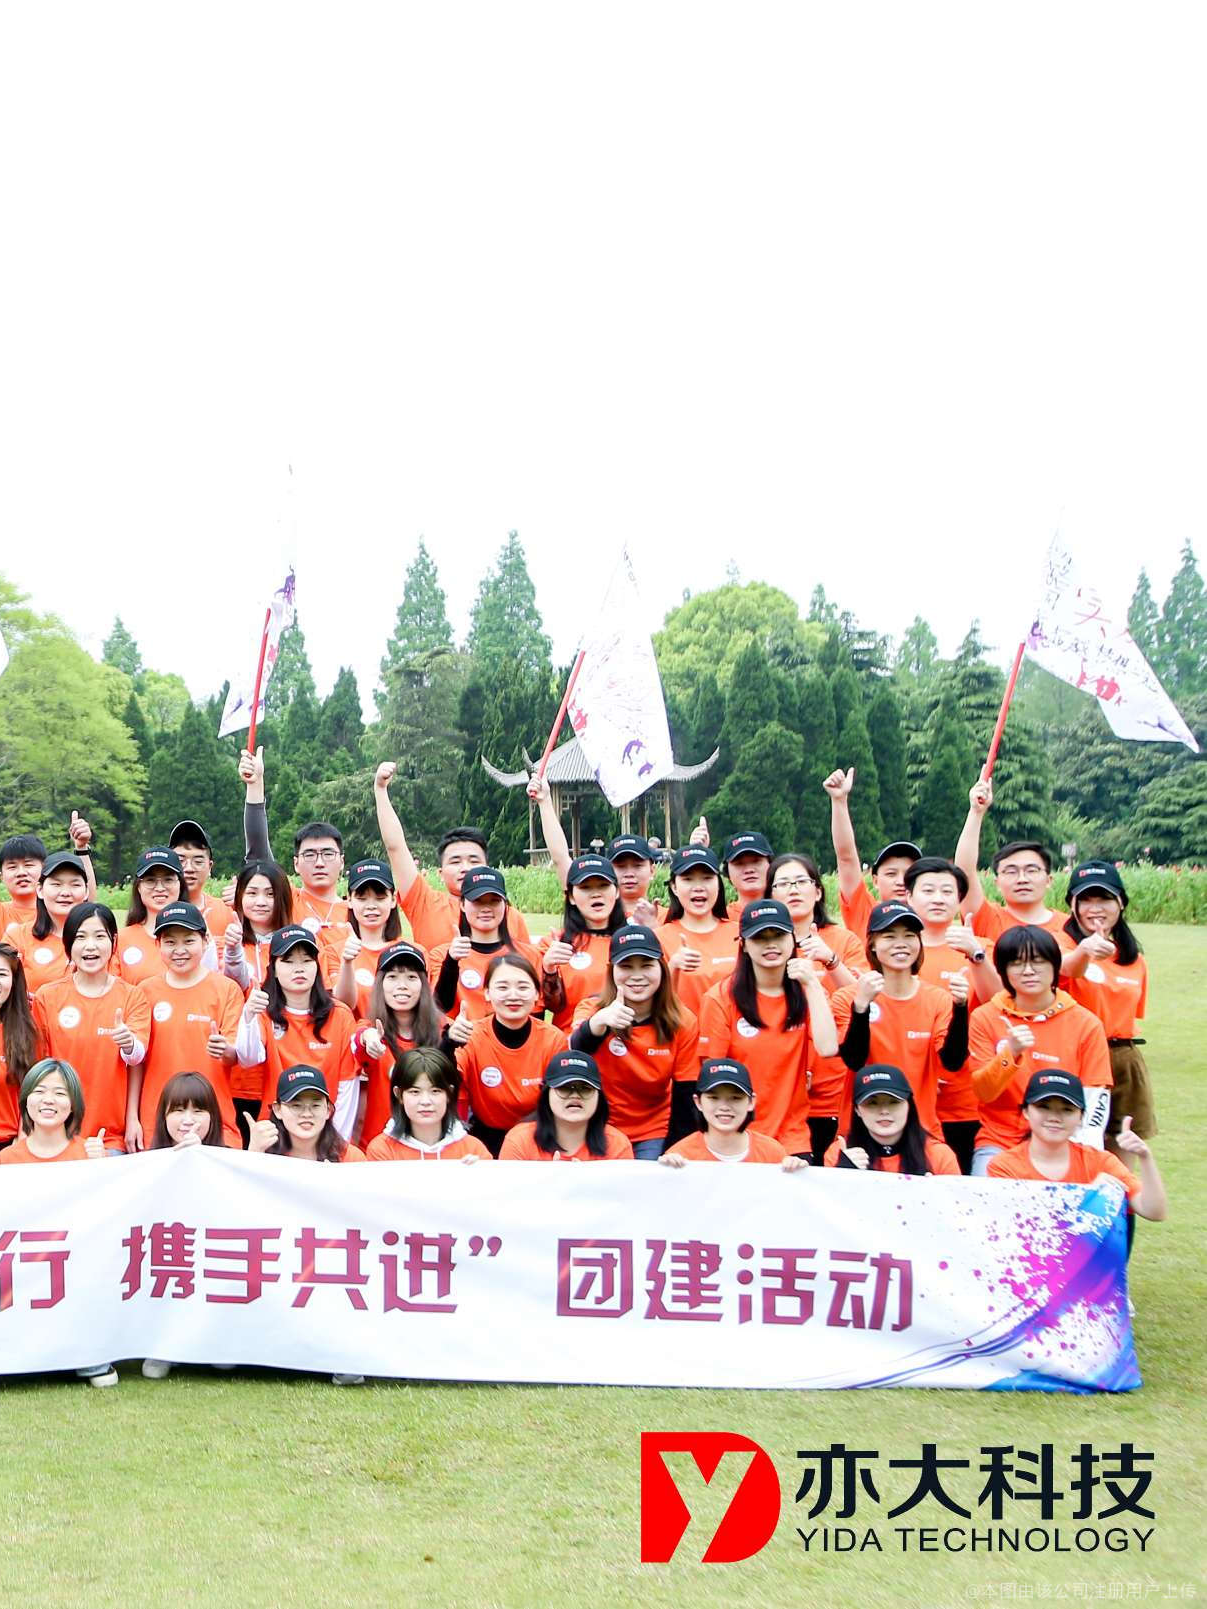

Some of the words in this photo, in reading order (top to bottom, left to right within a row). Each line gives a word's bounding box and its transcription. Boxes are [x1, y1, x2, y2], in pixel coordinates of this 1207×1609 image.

[120, 1221, 503, 1314] 携手共进”
[556, 1238, 914, 1333] 团建活动
